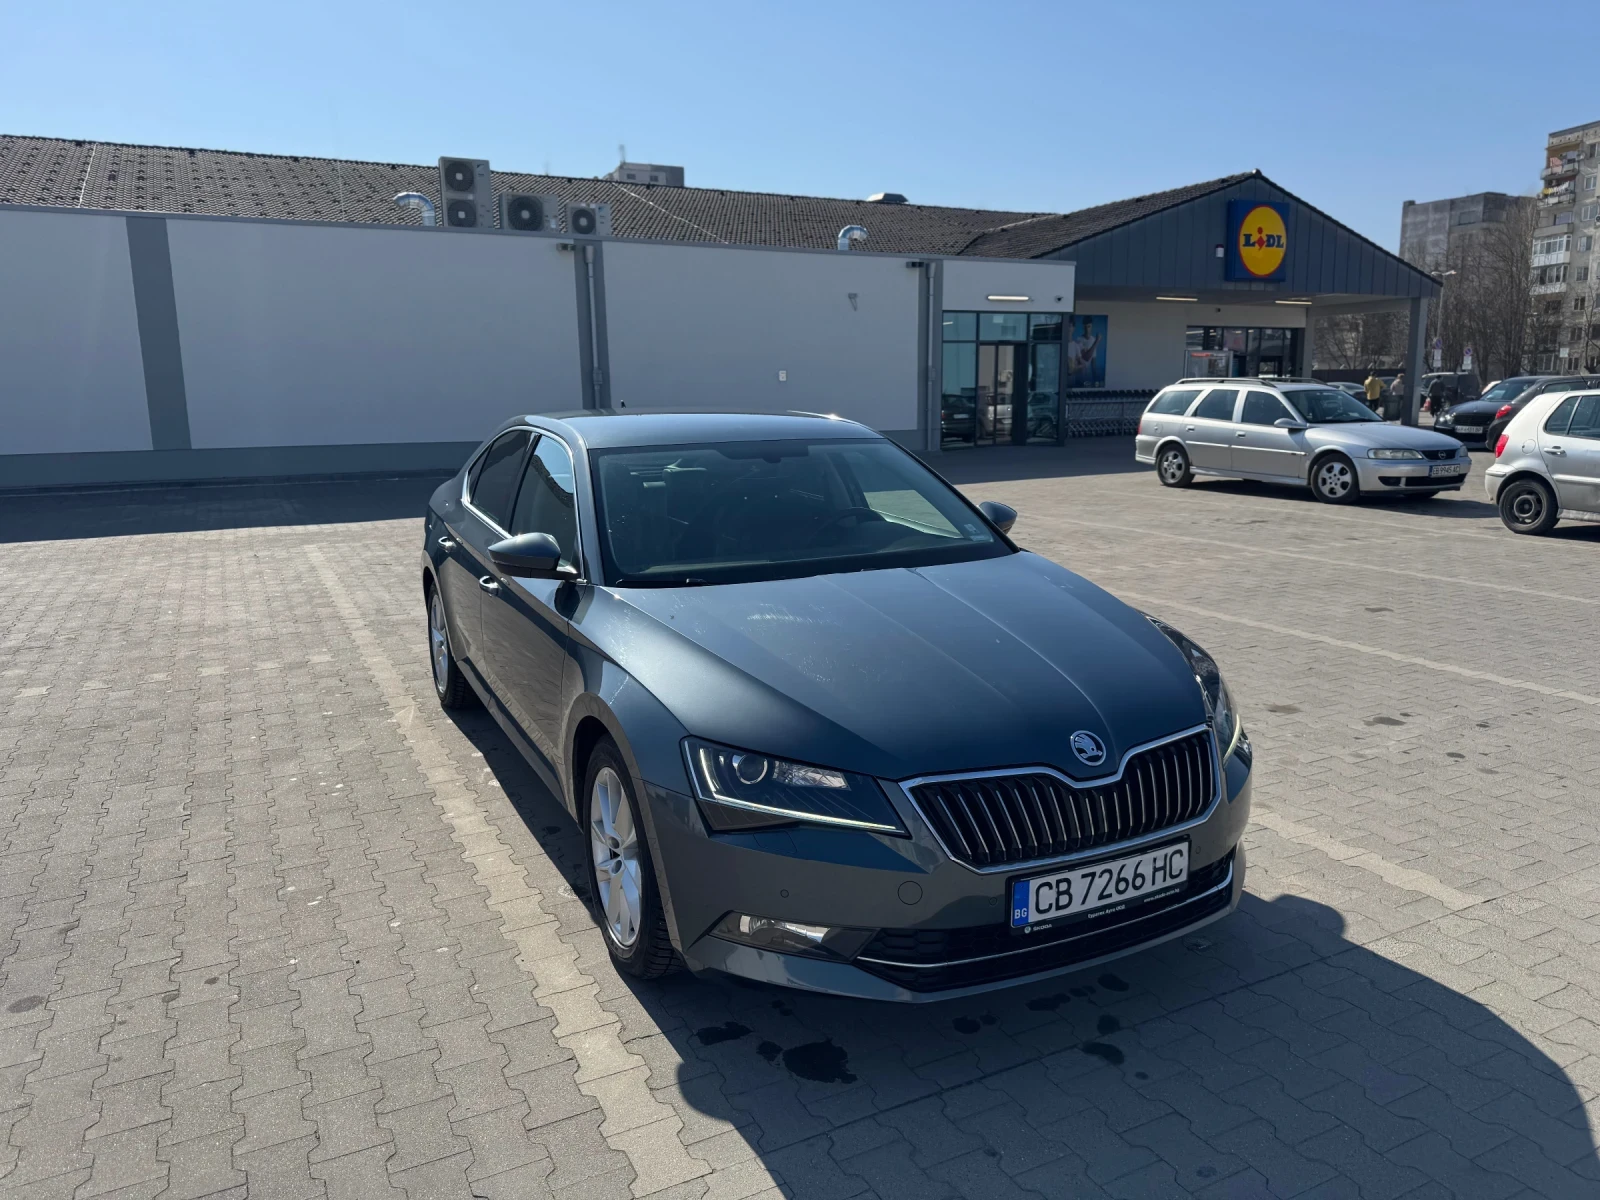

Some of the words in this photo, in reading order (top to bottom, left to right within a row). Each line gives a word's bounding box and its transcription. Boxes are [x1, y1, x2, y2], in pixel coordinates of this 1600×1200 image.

[1242, 226, 1284, 251] LIDL
[1035, 878, 1073, 915] CB
[1081, 859, 1146, 906] 7266
[1152, 849, 1184, 886] HC
[1014, 908, 1028, 919] BG
